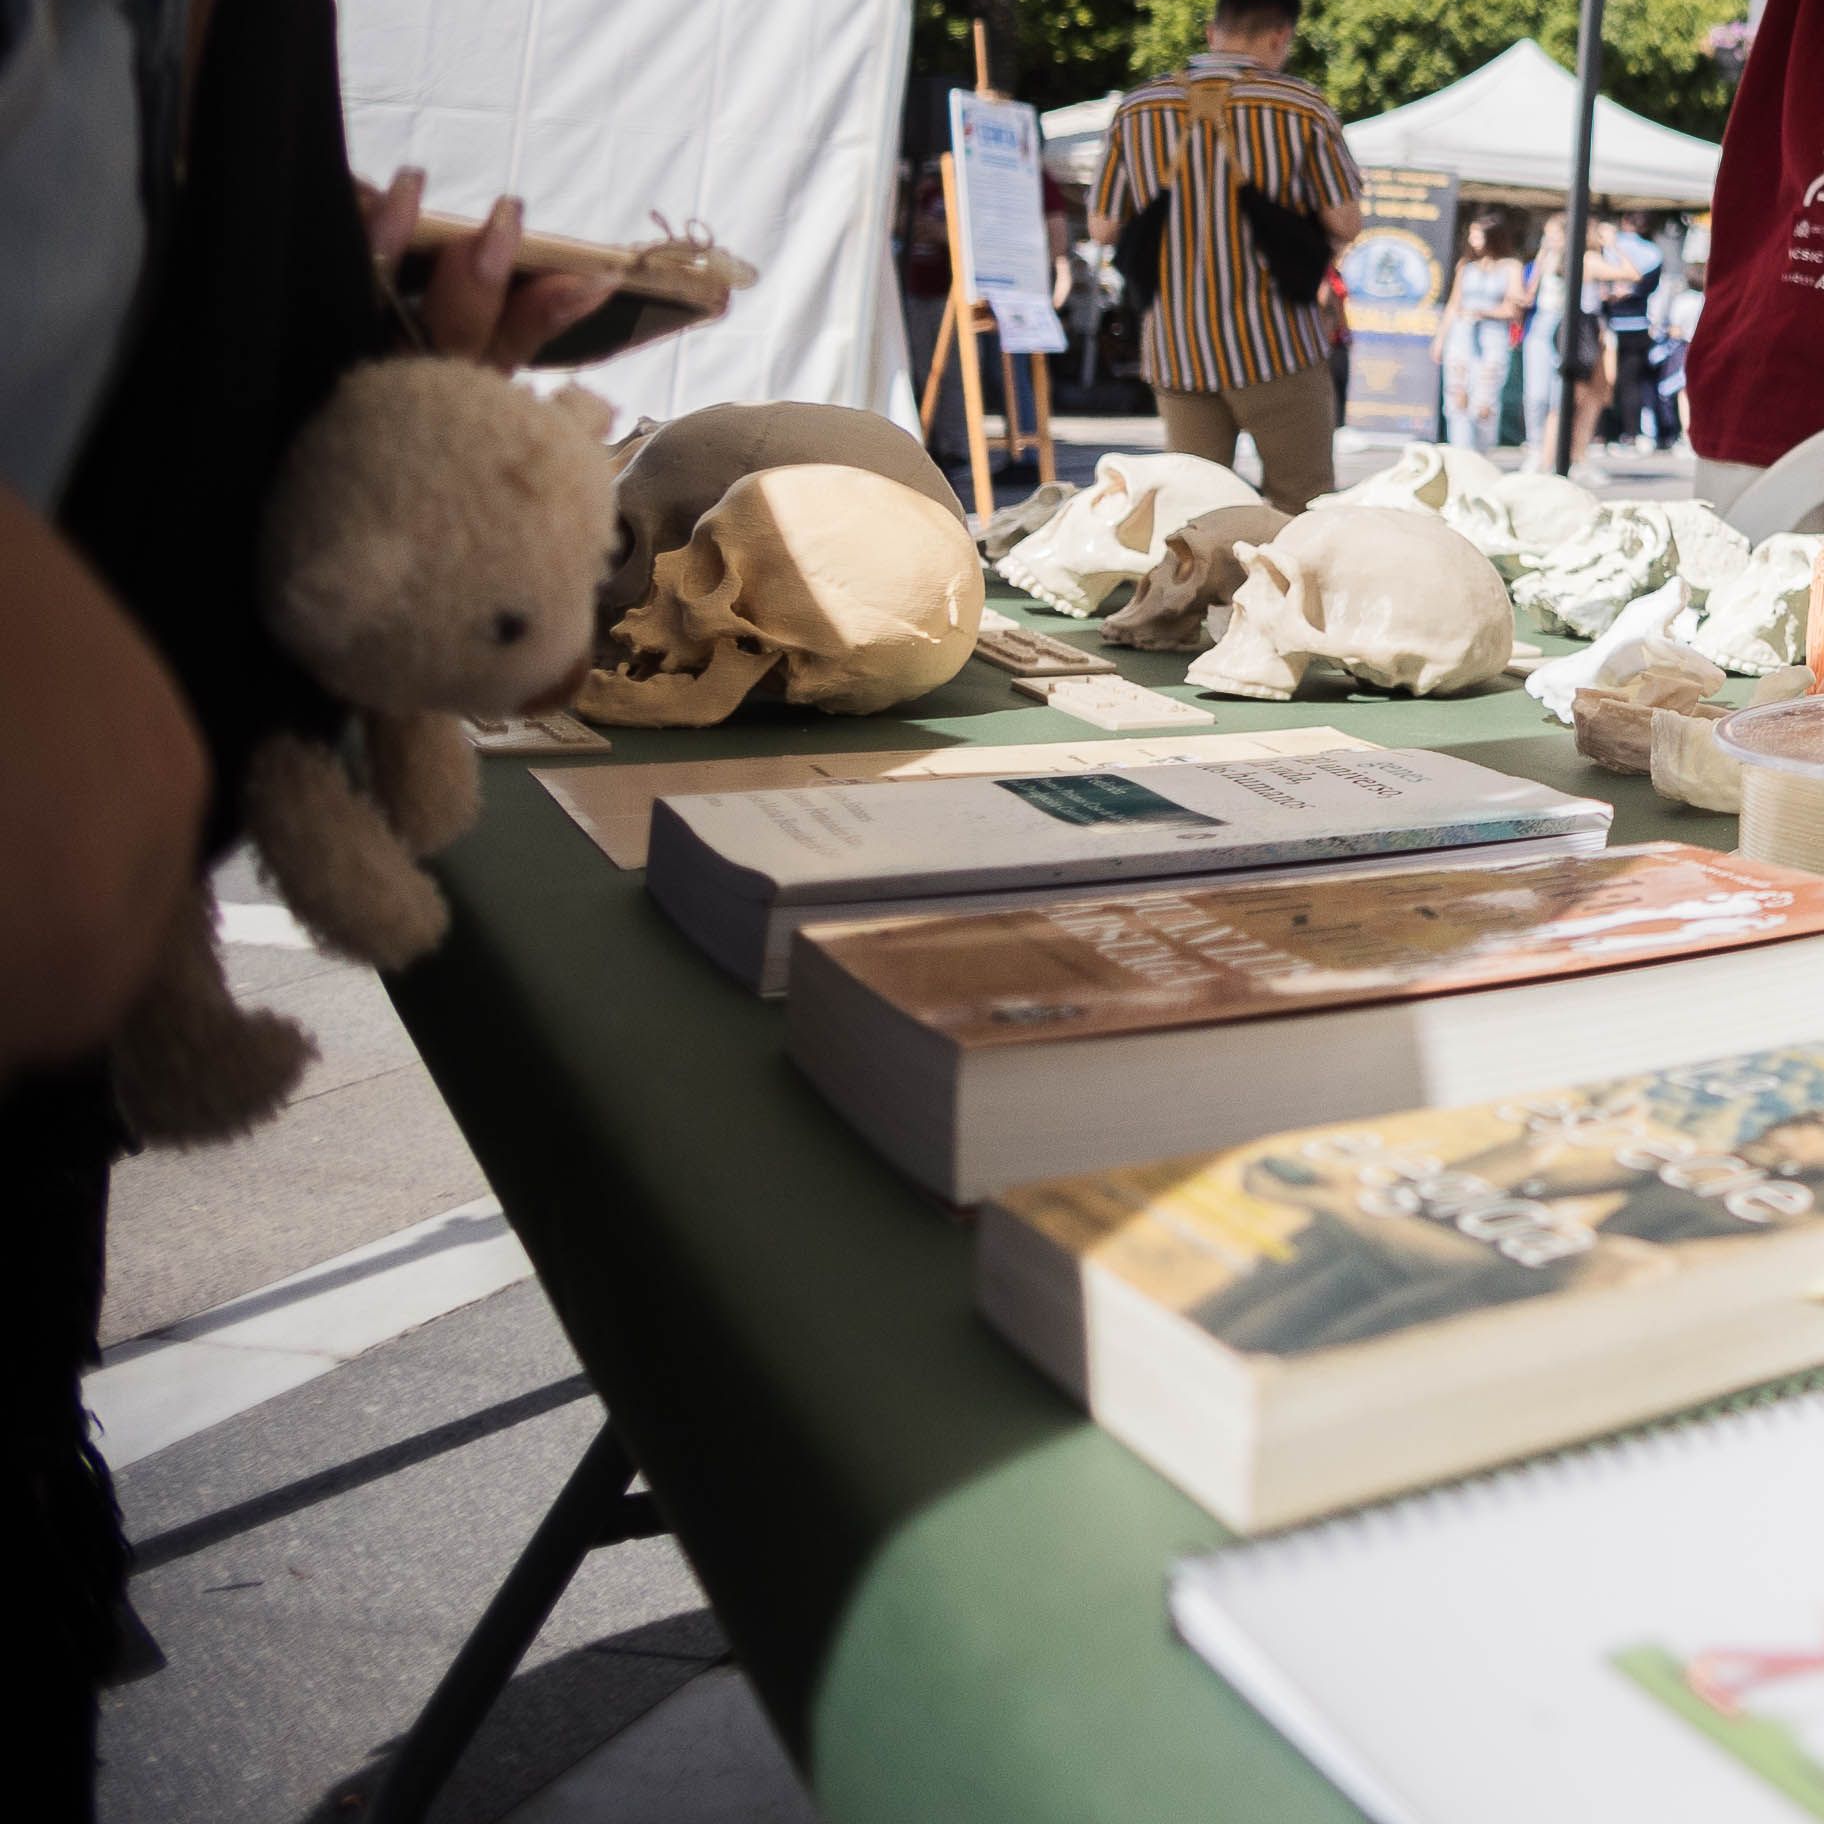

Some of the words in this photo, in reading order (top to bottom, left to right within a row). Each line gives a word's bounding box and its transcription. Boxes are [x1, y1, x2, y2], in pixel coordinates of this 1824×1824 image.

[1226, 770, 1317, 809] humanos
[1266, 764, 1317, 785] vida,
[1316, 762, 1403, 799] universo,
